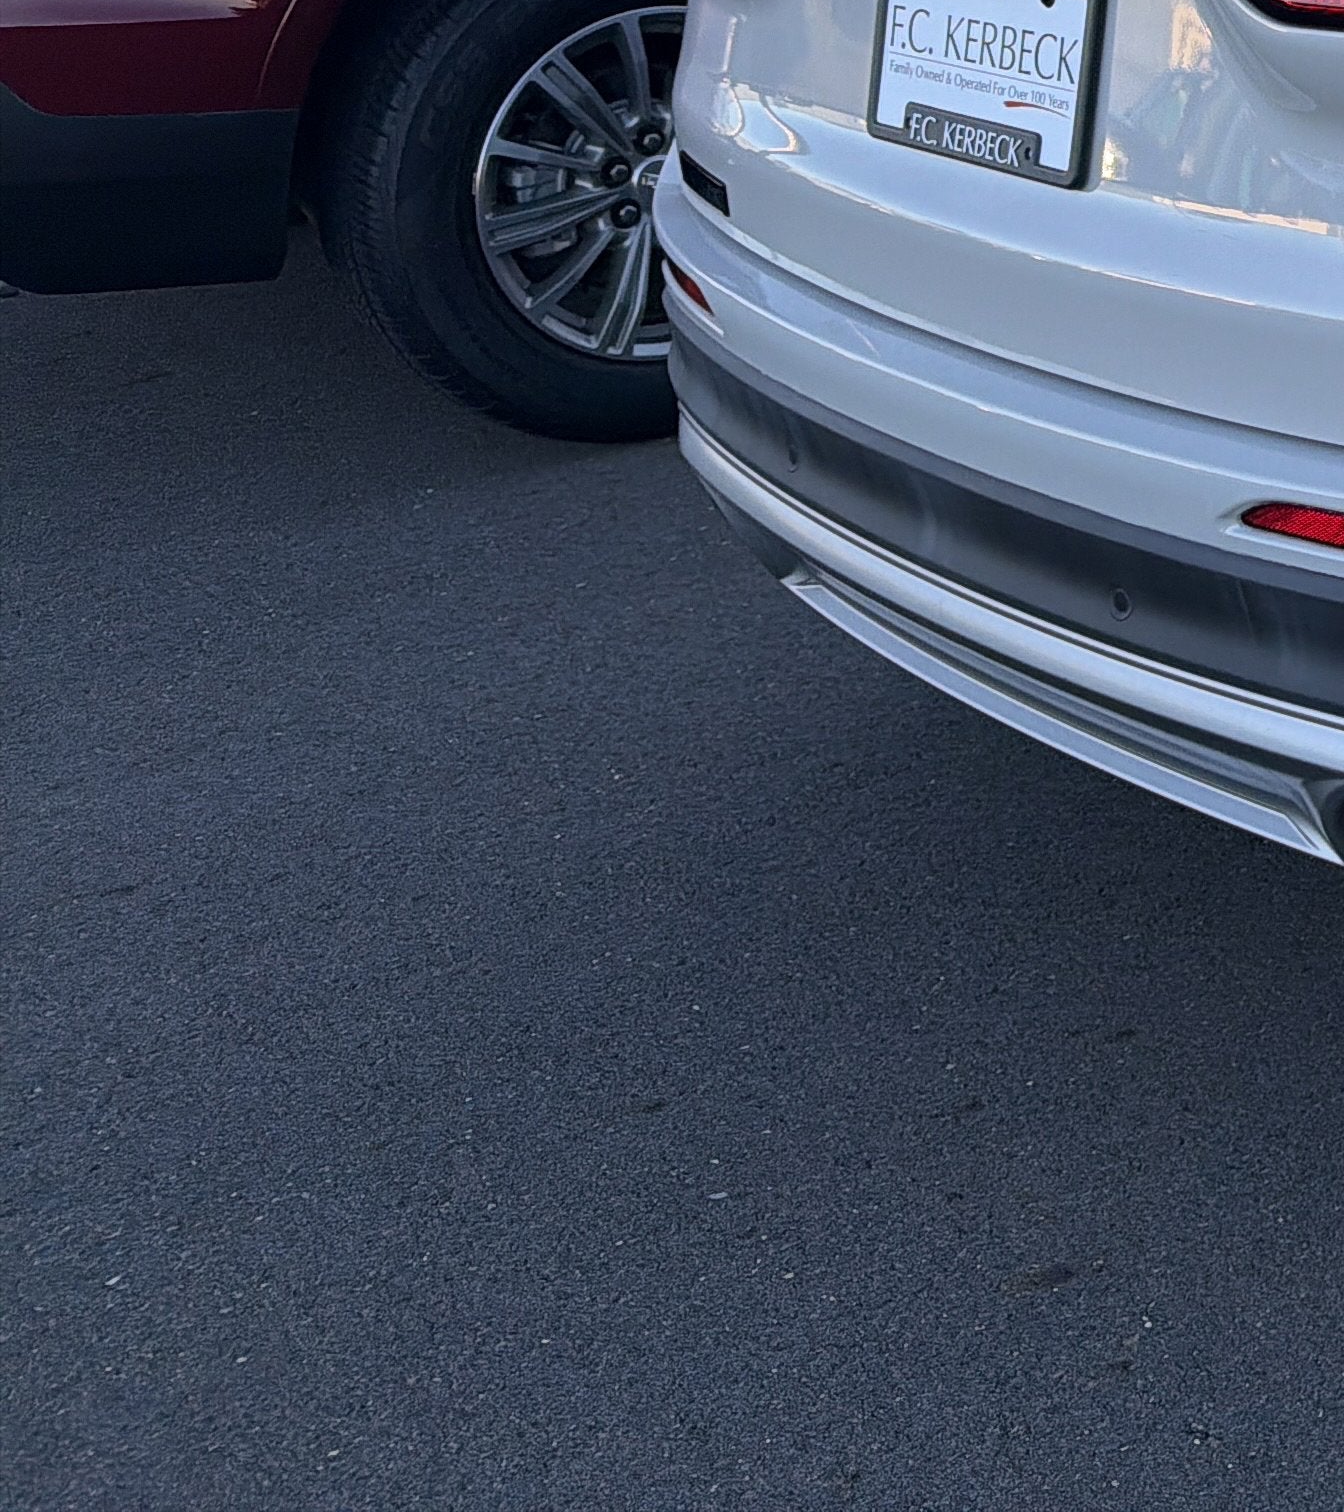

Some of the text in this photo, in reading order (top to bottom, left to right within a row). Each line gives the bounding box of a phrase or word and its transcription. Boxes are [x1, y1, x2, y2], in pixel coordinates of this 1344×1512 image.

[890, 5, 1079, 85] F.C. KERBECK
[889, 60, 1070, 111] Family Owned & Operated For Over 100 Years
[909, 112, 1022, 168] F.C. KERBECK
